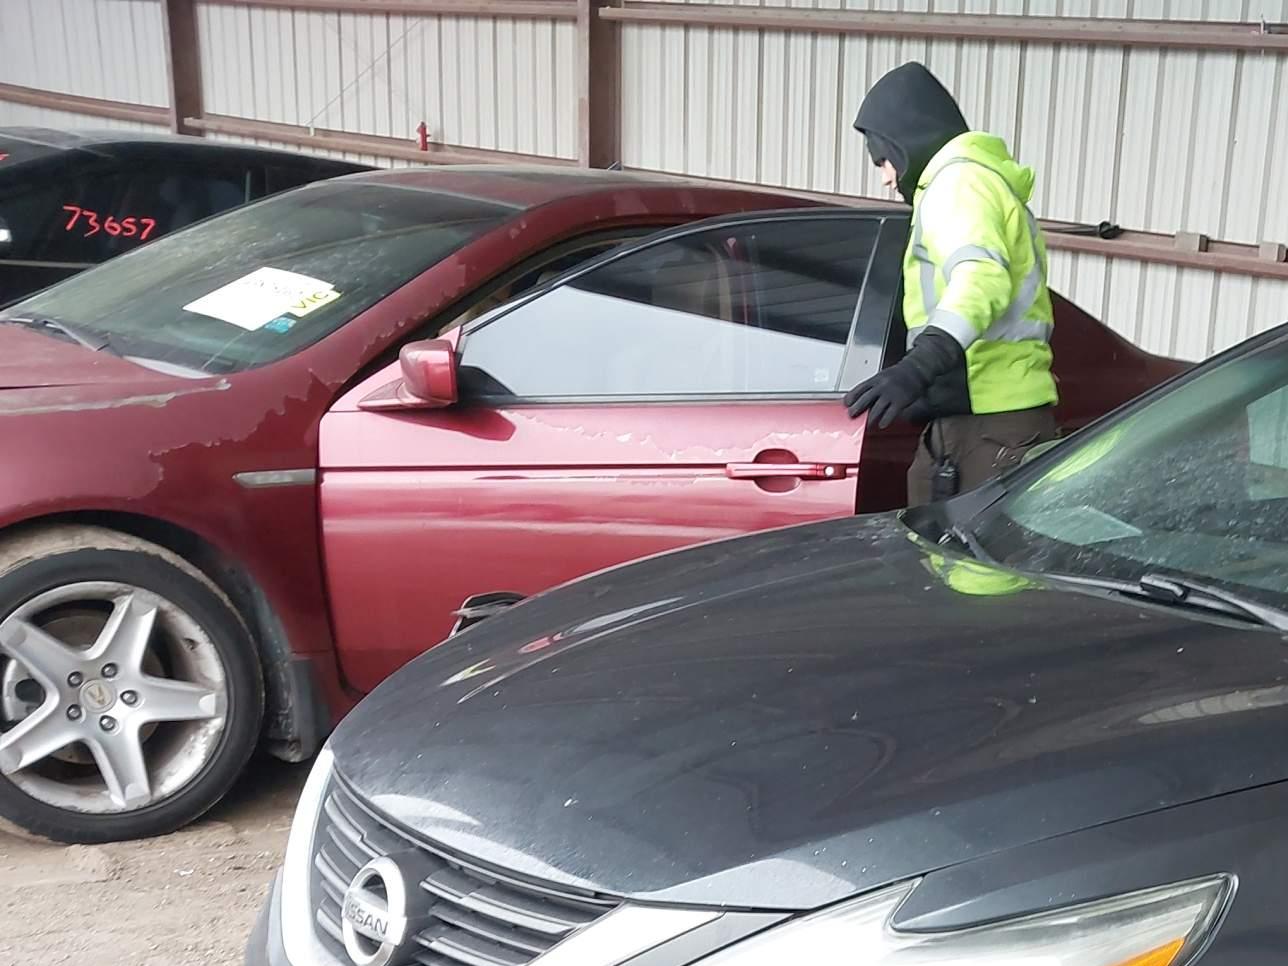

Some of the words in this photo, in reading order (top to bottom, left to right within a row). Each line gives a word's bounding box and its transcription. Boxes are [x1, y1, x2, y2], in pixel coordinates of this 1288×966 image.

[64, 205, 156, 240] 73657
[290, 291, 329, 309] VIC
[344, 900, 388, 937] SSAN
